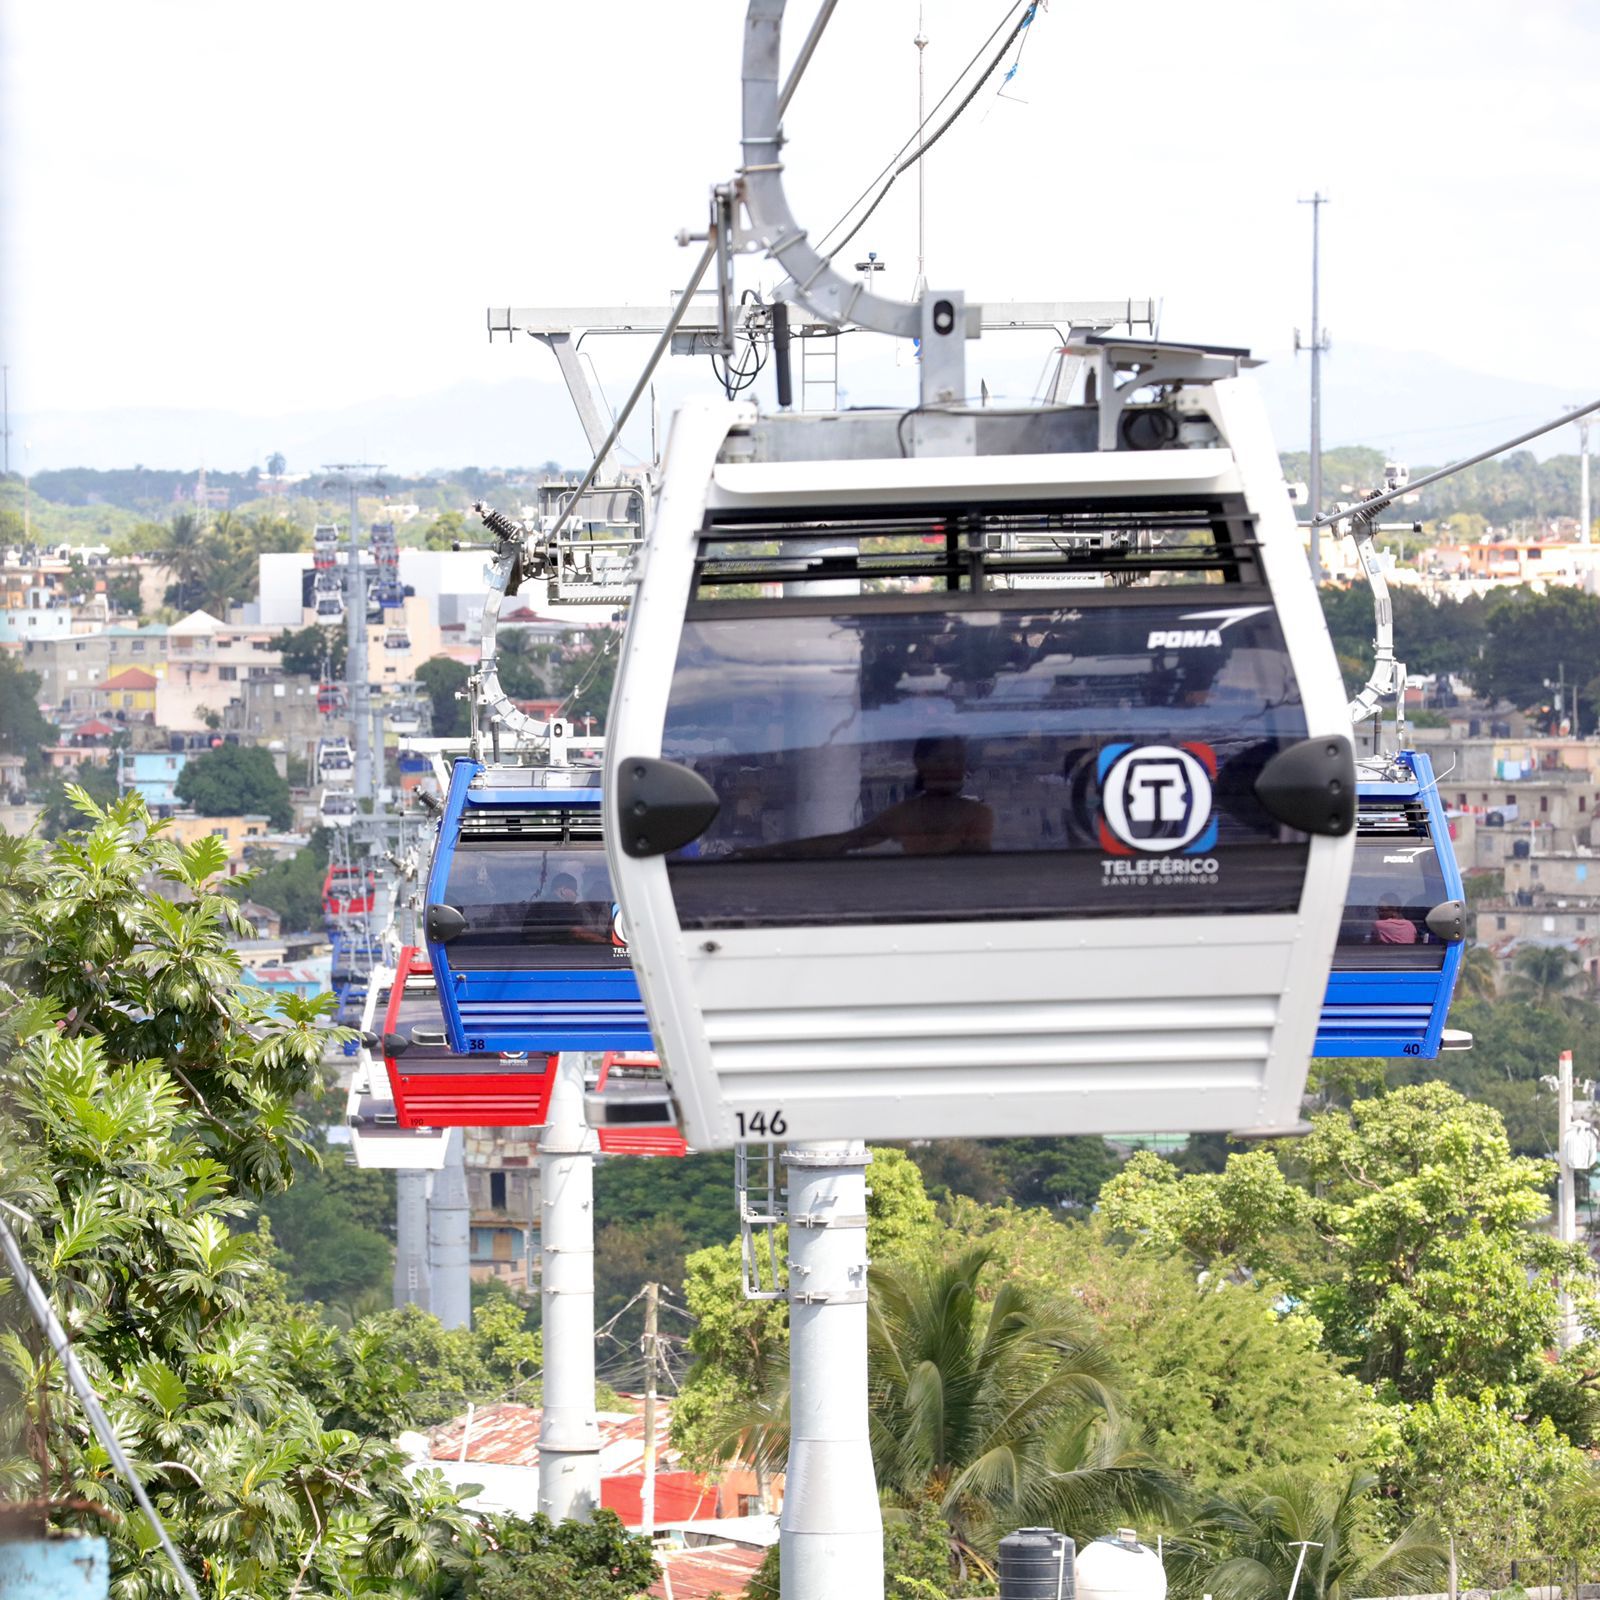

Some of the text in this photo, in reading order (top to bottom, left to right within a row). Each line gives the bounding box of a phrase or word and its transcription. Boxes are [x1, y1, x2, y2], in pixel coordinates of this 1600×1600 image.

[1147, 630, 1222, 649] POMA
[1383, 855, 1414, 864] POMA
[1101, 856, 1219, 876] TELEFÉRICO
[1101, 874, 1219, 887] SANTO DOMINGO
[469, 1039, 485, 1050] 38
[1403, 1043, 1420, 1055] 40
[410, 1118, 424, 1126] 190
[735, 1110, 787, 1137] 146
